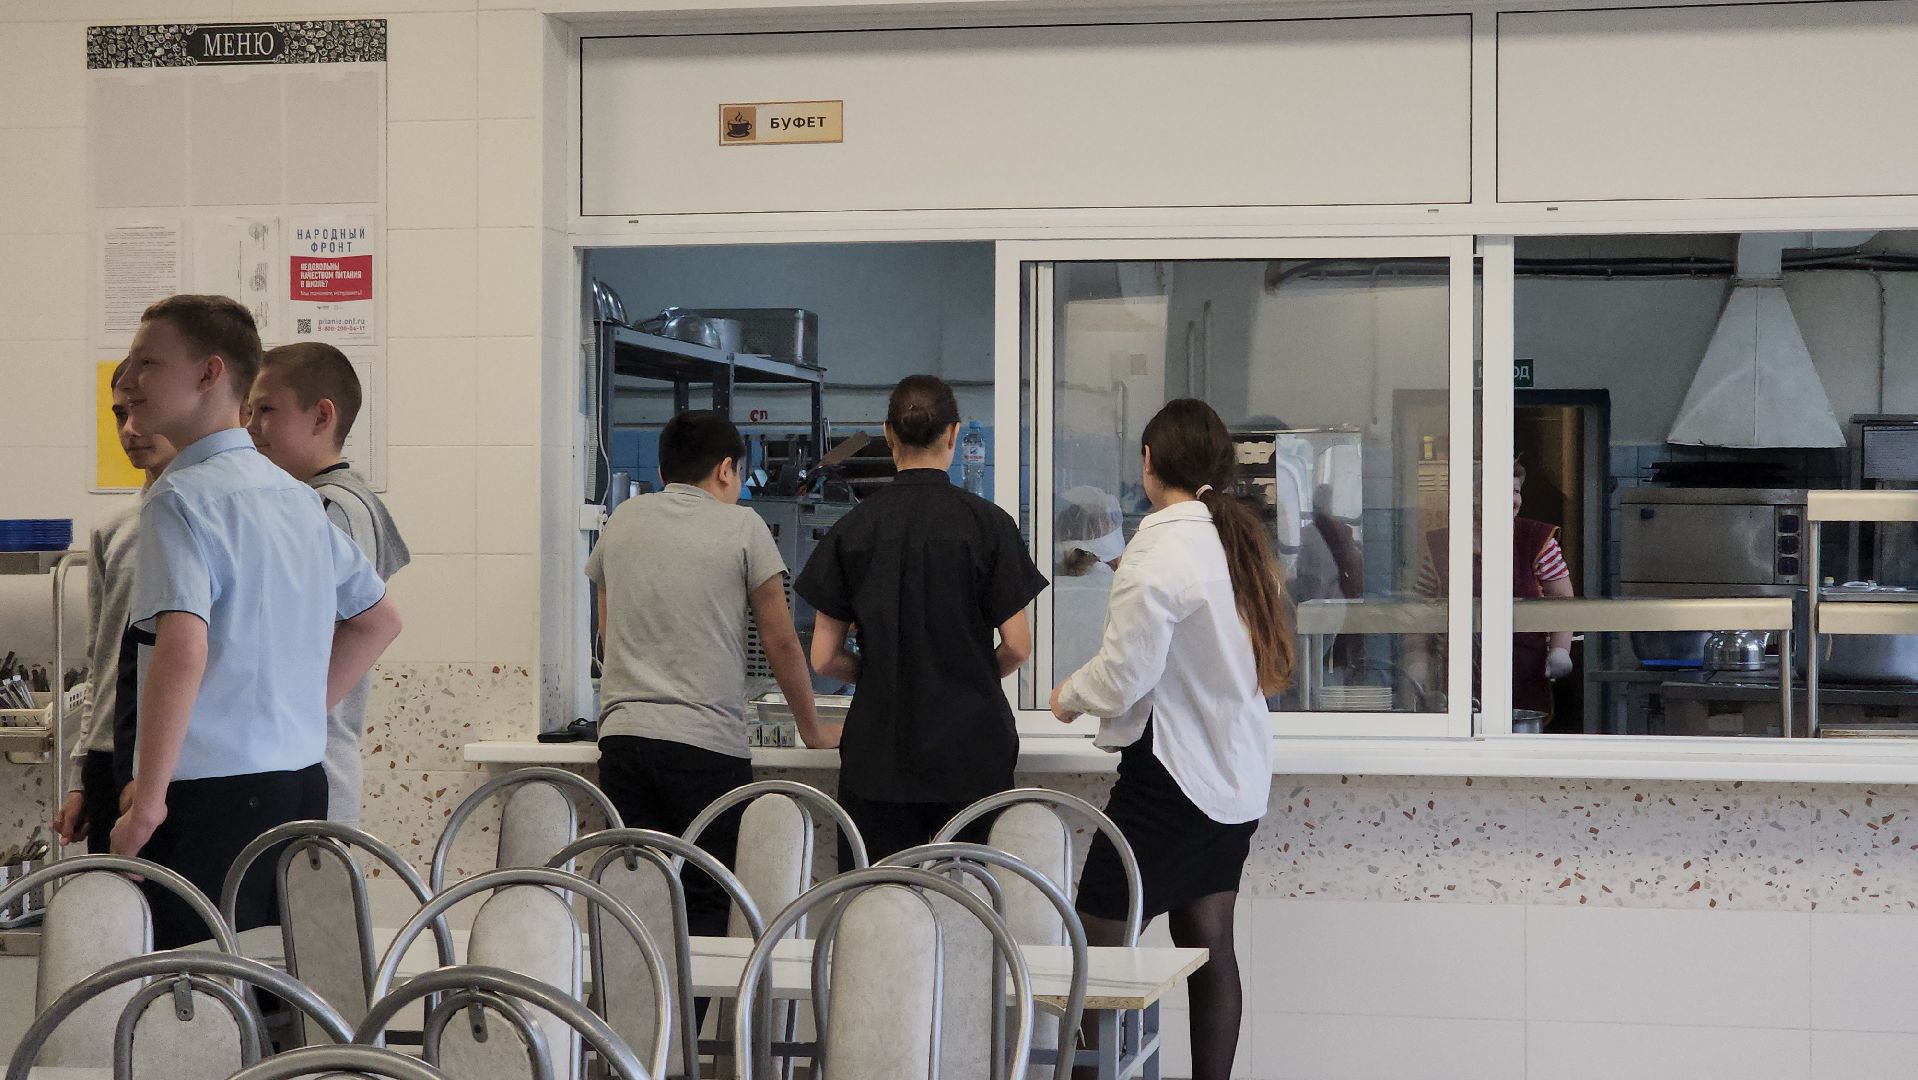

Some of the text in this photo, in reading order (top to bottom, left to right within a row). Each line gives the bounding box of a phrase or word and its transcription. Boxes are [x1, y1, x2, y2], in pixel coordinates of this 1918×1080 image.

[203, 31, 275, 57] МЕНЮ
[770, 116, 826, 131] БУФЕТ
[297, 228, 365, 240] НАРОДНЫЙ
[311, 242, 352, 253] ФРОНТ
[301, 262, 339, 271] НЕДОВОЛЬНЫ
[301, 270, 362, 279] КАЧЕСТВОМ ПИТАНИЯ
